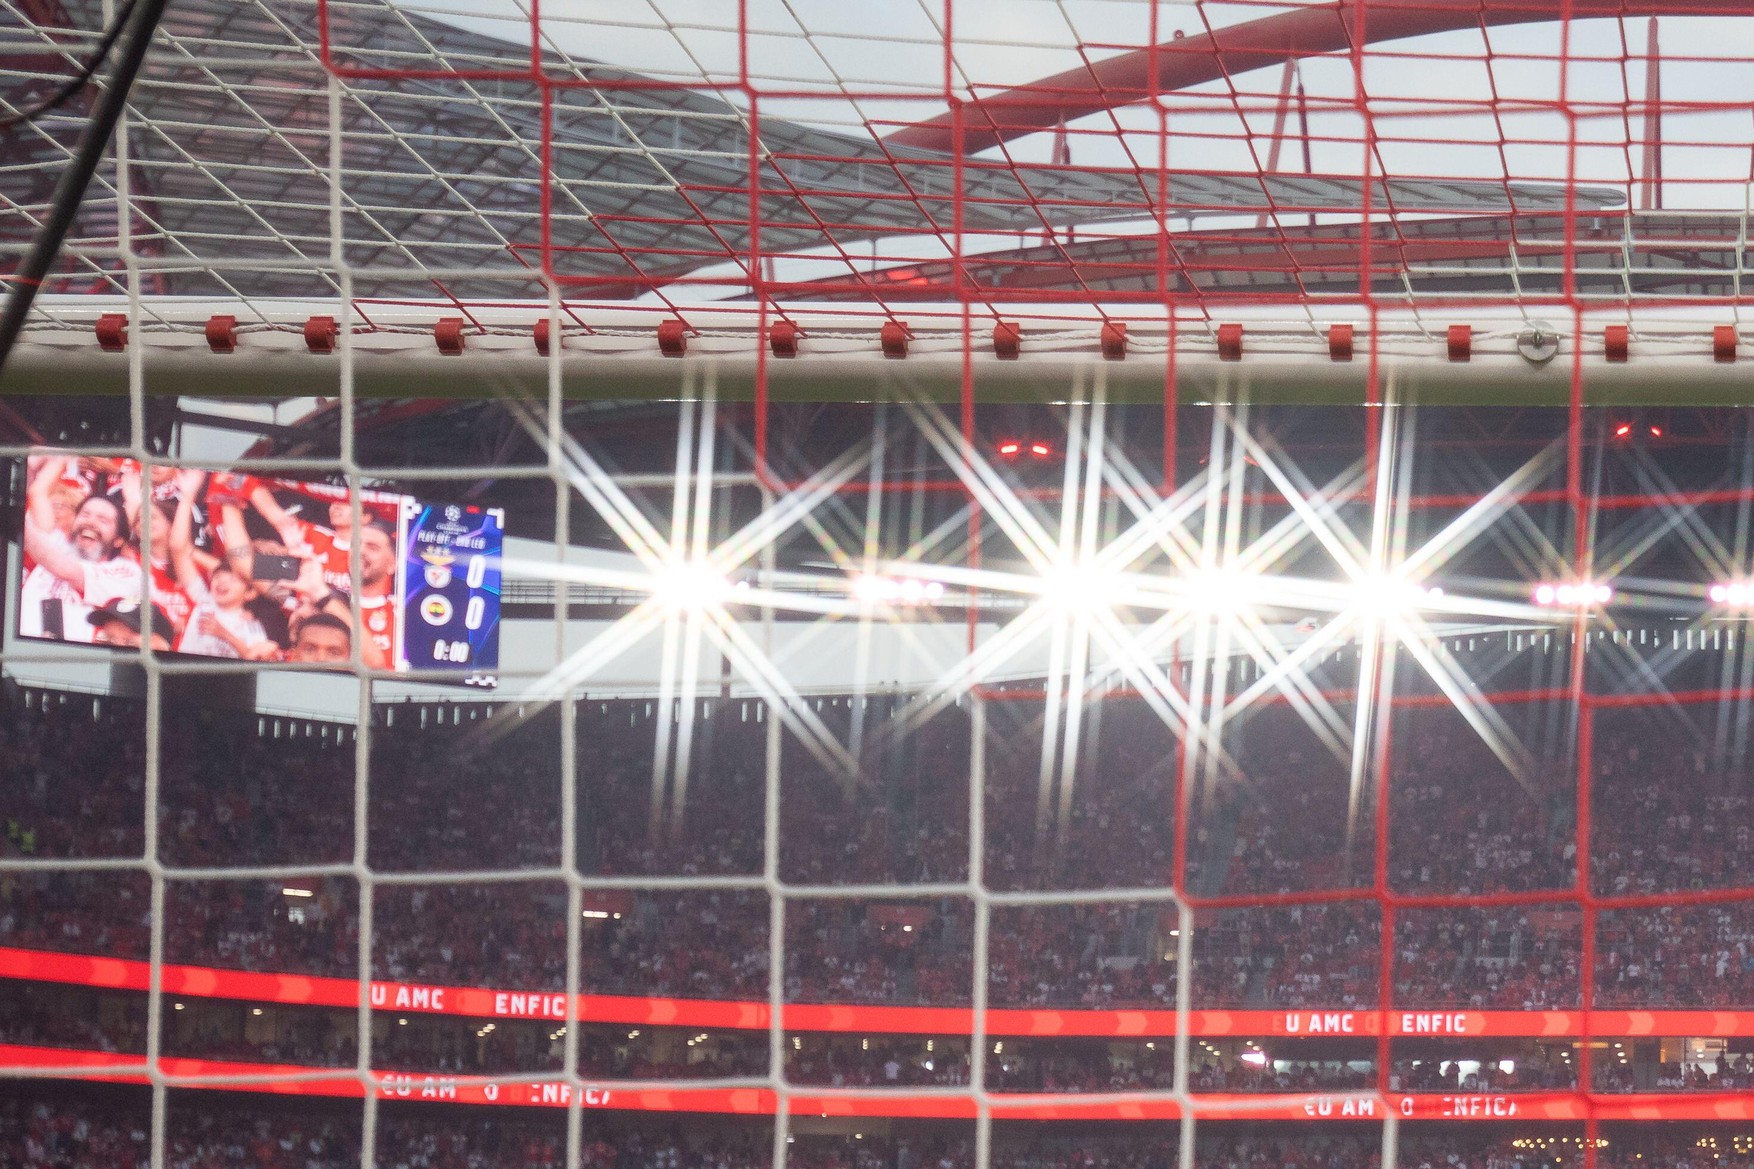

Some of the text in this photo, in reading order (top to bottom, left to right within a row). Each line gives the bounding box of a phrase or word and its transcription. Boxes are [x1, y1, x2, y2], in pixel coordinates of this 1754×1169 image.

[466, 554, 486, 588] 0
[465, 595, 485, 630] 0
[433, 639, 470, 663] 0:00
